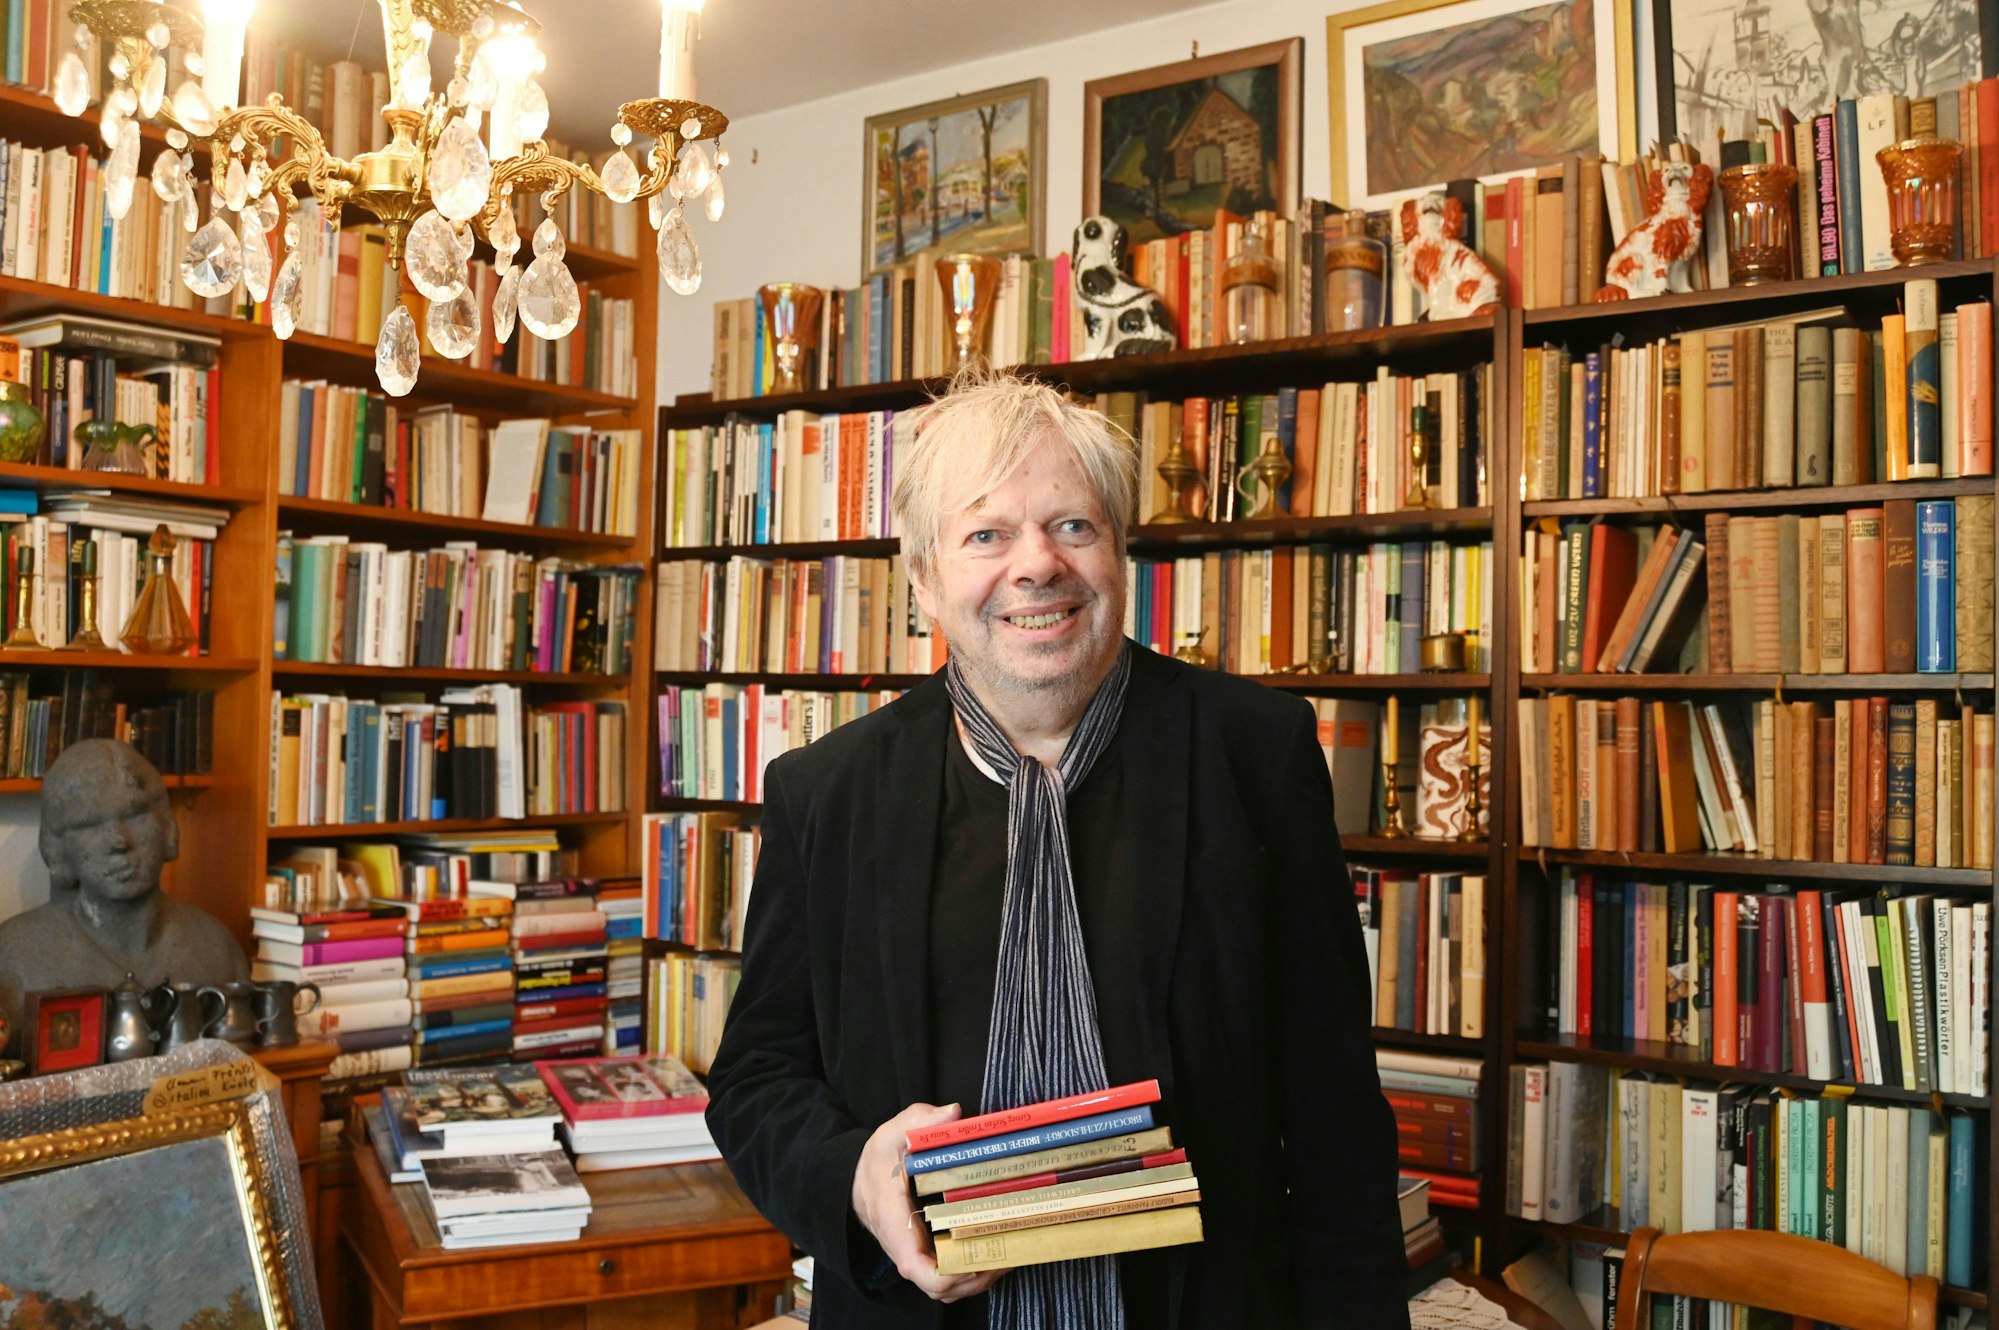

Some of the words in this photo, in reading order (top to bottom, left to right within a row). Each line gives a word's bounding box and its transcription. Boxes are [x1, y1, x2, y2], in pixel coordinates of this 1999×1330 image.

[1815, 117, 1831, 160] Kabinett
[1819, 160, 1835, 203] geheime
[1820, 204, 1835, 226] Das
[1821, 227, 1837, 261] BILBO
[803, 706, 813, 746] witters
[1937, 907, 1948, 928] Uwe
[1938, 929, 1950, 970] Pörksen
[1938, 971, 1952, 1057] Plastikwörter
[984, 1118, 1008, 1129] Stefan
[1007, 1113, 1032, 1124] Georg
[1790, 1111, 1798, 1137] PROSA
[1805, 1111, 1813, 1137] PROSA
[919, 1134, 930, 1143] Fe
[930, 1130, 950, 1139] Santa
[958, 1123, 984, 1135] Troller
[1008, 1135, 1041, 1150] BRIEFE
[913, 1146, 982, 1169] DEUTSCHLAND
[982, 1200, 998, 1209] DER
[1038, 1190, 1058, 1199] WEIL
[1150, 1197, 1175, 1207] RUDOLF
[962, 1204, 982, 1213] WELT
[974, 1225, 998, 1235] KULTUR
[1825, 1225, 1834, 1245] LGA
[1607, 1263, 1617, 1301] fenster
